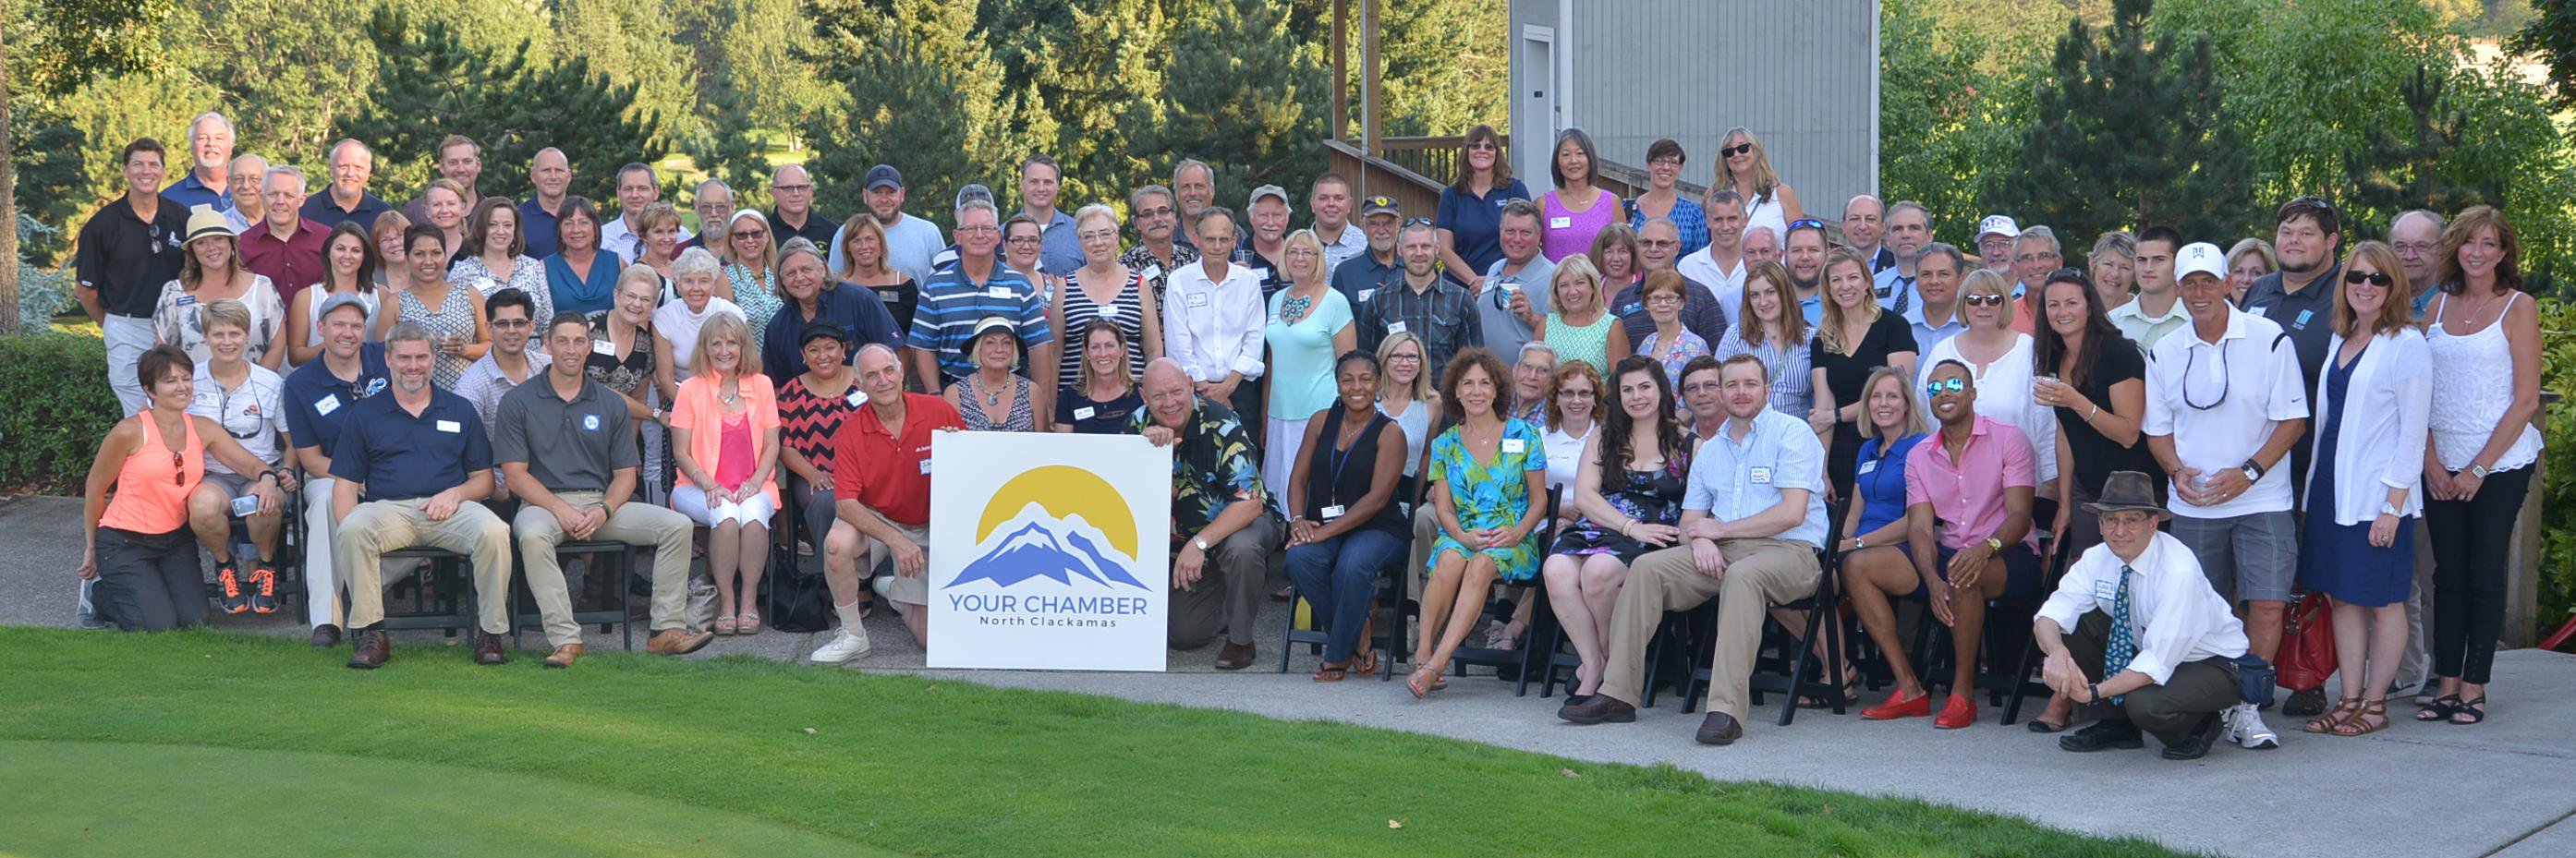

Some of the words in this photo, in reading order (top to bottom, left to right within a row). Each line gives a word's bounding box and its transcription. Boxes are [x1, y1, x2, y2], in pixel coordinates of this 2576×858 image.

[949, 594, 1017, 612] YOUR
[1024, 596, 1148, 615] CHAMBER
[979, 616, 1025, 626] North
[1030, 616, 1117, 628] Clackamas
